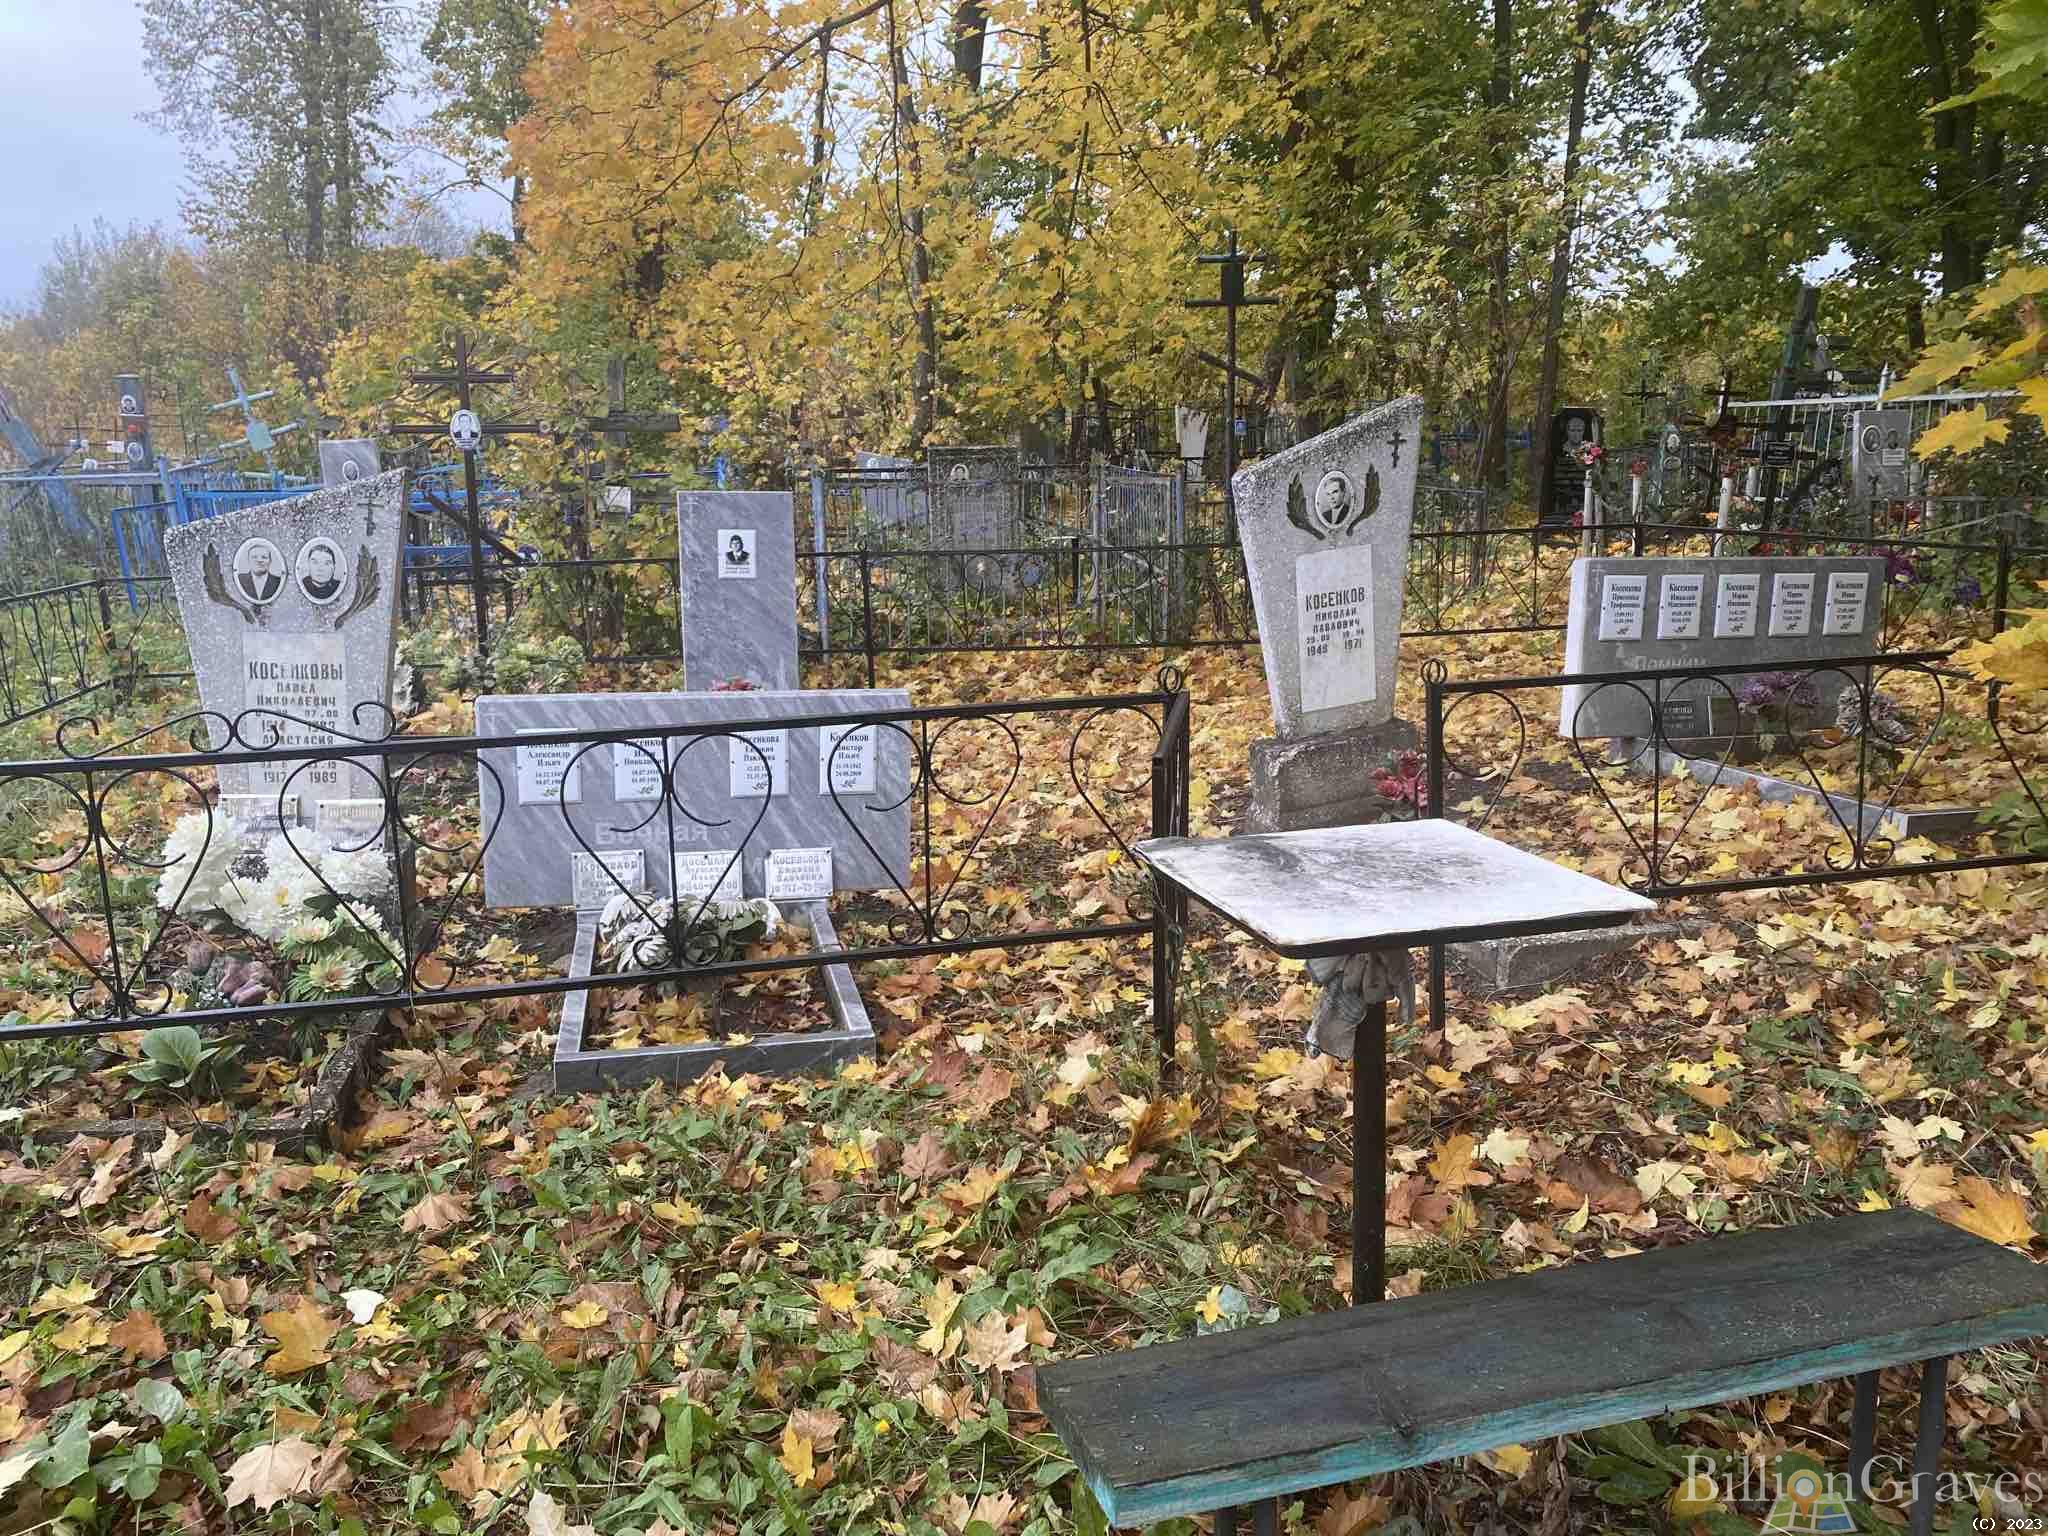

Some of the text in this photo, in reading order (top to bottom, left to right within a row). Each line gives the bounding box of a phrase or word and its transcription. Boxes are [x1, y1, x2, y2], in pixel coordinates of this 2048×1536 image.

[1305, 586, 1365, 612] КОСЕНКОВ
[1315, 607, 1357, 621] НИКОЛАЙ
[1313, 619, 1360, 633] ПАВЛОВИЧ
[249, 661, 343, 681] КОСЕНКОВЫ
[276, 681, 316, 693] ПАВЕЛ
[256, 695, 337, 707] НИКОЛАЕВИЧ
[739, 735, 779, 745] енкова
[830, 731, 869, 743] Коенков
